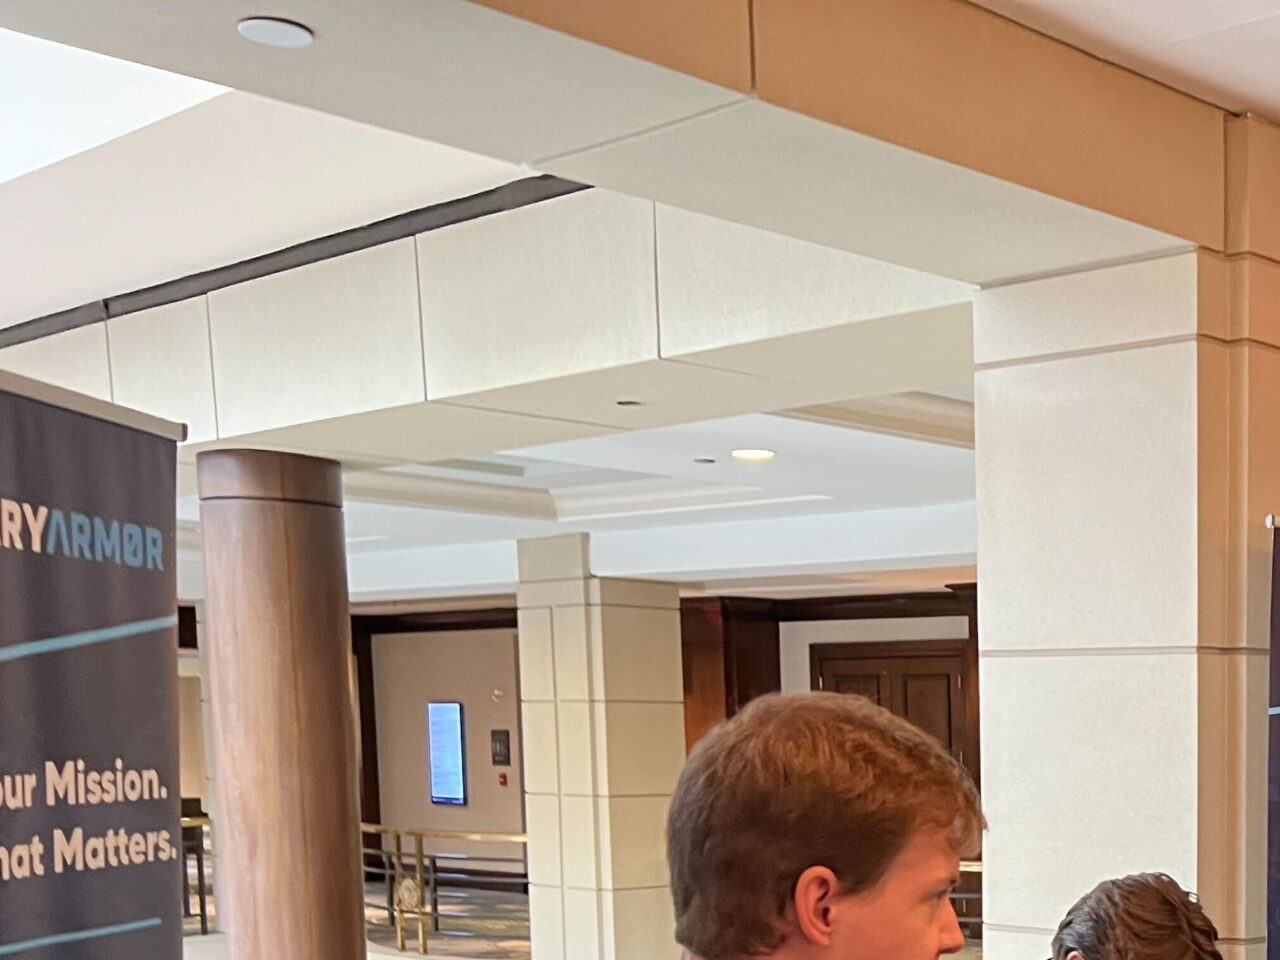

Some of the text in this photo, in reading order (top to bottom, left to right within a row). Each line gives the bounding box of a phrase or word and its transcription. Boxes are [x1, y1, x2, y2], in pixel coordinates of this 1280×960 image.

[0, 498, 165, 571] RYARMOR
[0, 758, 168, 810] ur Mission.
[53, 827, 177, 874] Matters.
